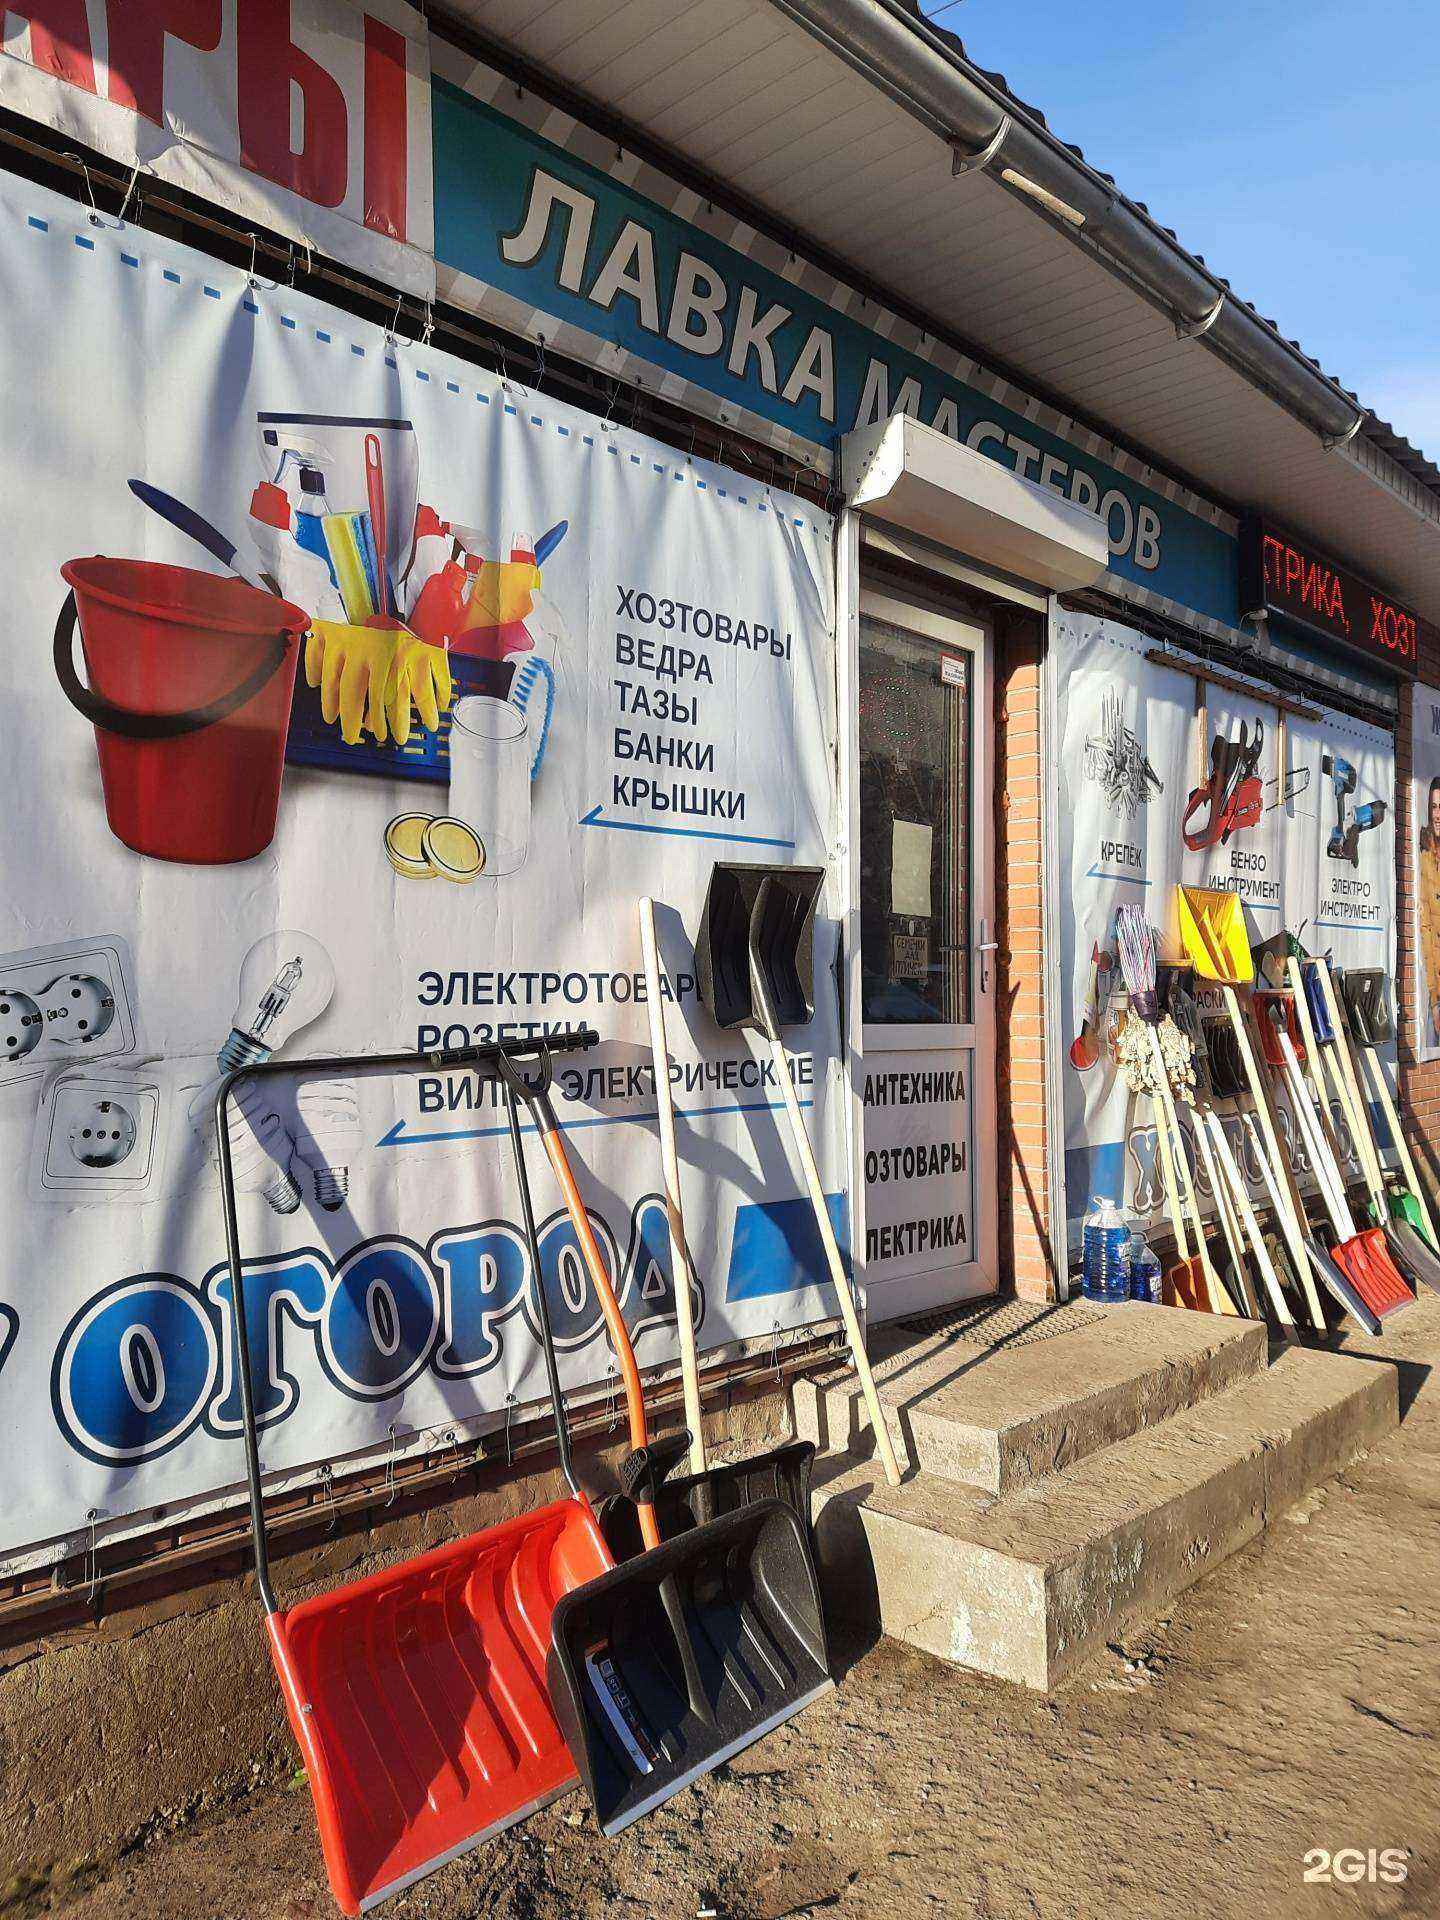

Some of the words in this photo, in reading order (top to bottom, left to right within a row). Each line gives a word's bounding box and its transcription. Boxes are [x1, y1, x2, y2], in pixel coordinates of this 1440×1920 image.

[500, 168, 836, 424] ЛАВКА
[1263, 534, 1351, 635] ТРИКА,
[616, 584, 792, 661] ХОЗТОВАРЫ
[615, 632, 714, 685] ВЕДРА
[613, 679, 698, 726] ТАЗЫ
[613, 727, 715, 773] БАНКИ
[613, 774, 746, 821] КРЫШКИ
[1100, 840, 1142, 868] КРЕПЁЖ
[1230, 850, 1267, 872] БЕНЗО
[1208, 874, 1281, 899] ИНСТРУМЕНТ
[1331, 877, 1371, 897] ЭЛЕКТРО
[1319, 900, 1381, 921] ИНСТРУМЕНТ
[417, 971, 703, 1005] ЭЛЕКТРОТОВАР
[864, 1071, 966, 1107] АНТЕХНИКА
[864, 1141, 967, 1184] ОЗТОВАРЫ
[865, 1213, 967, 1262] ЛЕКТРИКА
